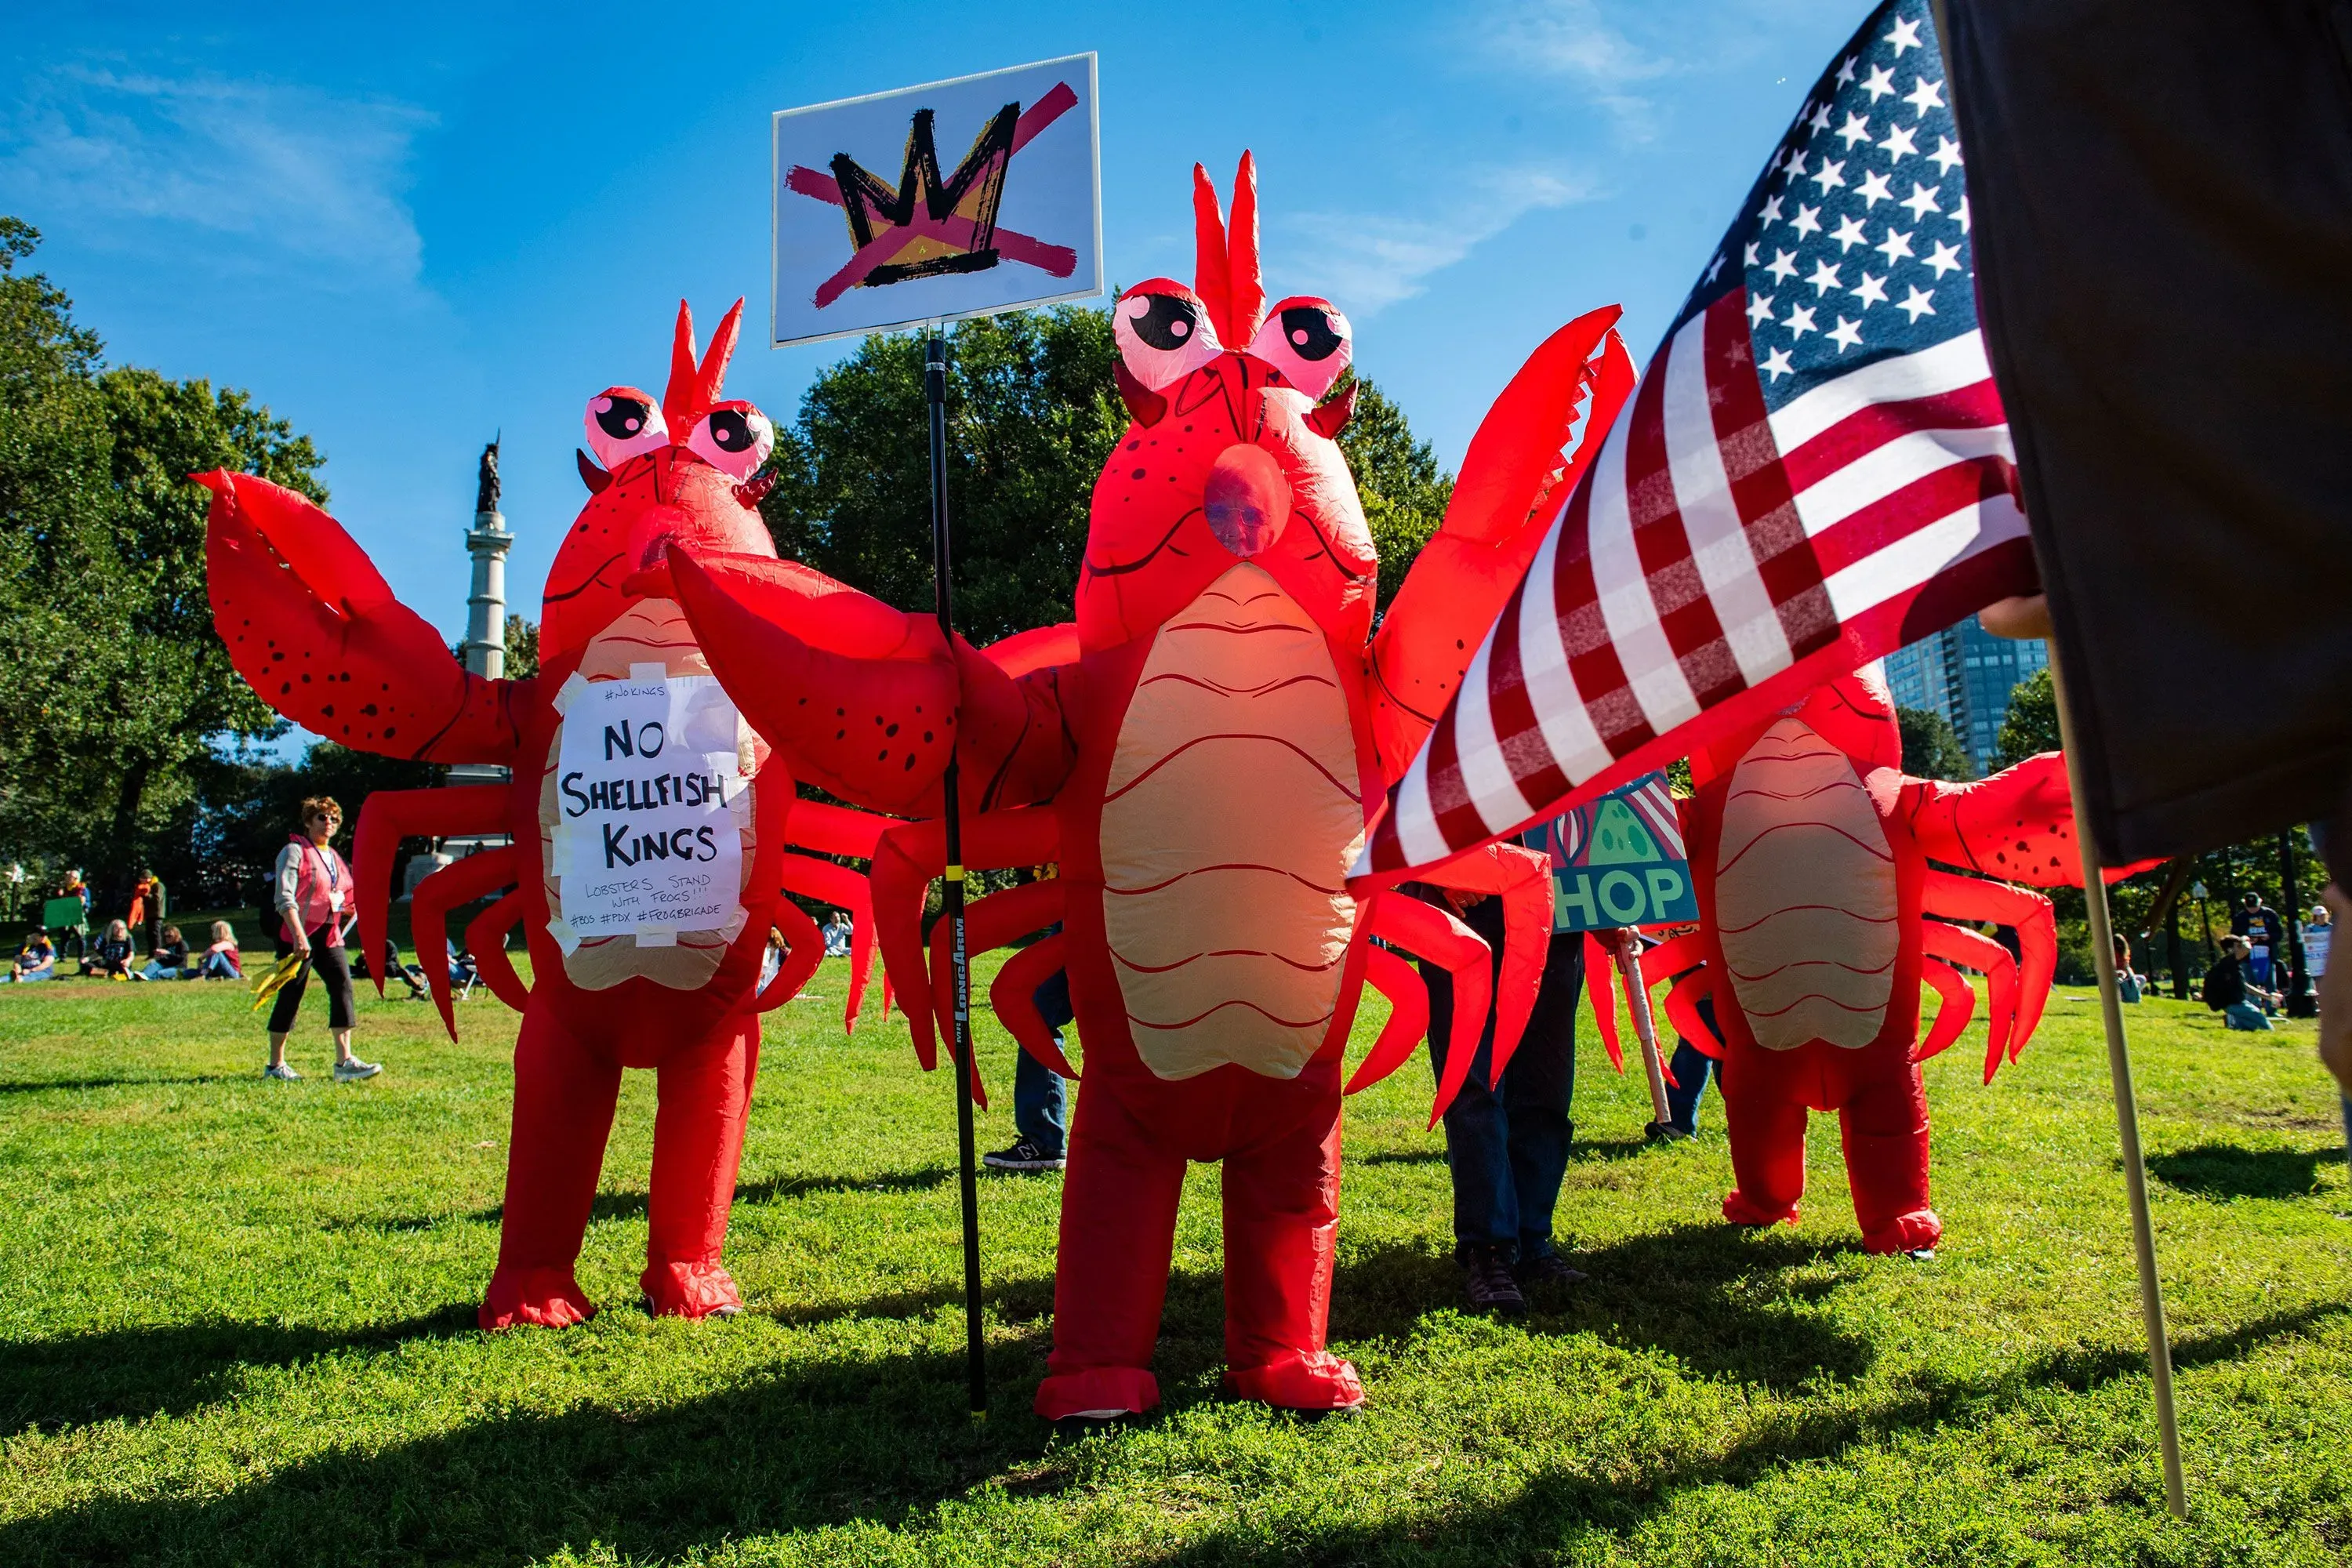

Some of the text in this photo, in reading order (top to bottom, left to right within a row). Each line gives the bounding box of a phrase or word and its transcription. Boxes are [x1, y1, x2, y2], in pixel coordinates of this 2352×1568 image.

[604, 719, 664, 760] NO
[561, 771, 728, 818] SHELLFISH
[602, 823, 717, 869] KINGS
[585, 874, 711, 898] LOBSTERS STAND
[612, 896, 641, 909] WITH
[1552, 868, 1684, 928] HOP
[570, 903, 722, 928] #BOS #PDX #FROGBRIGADE
